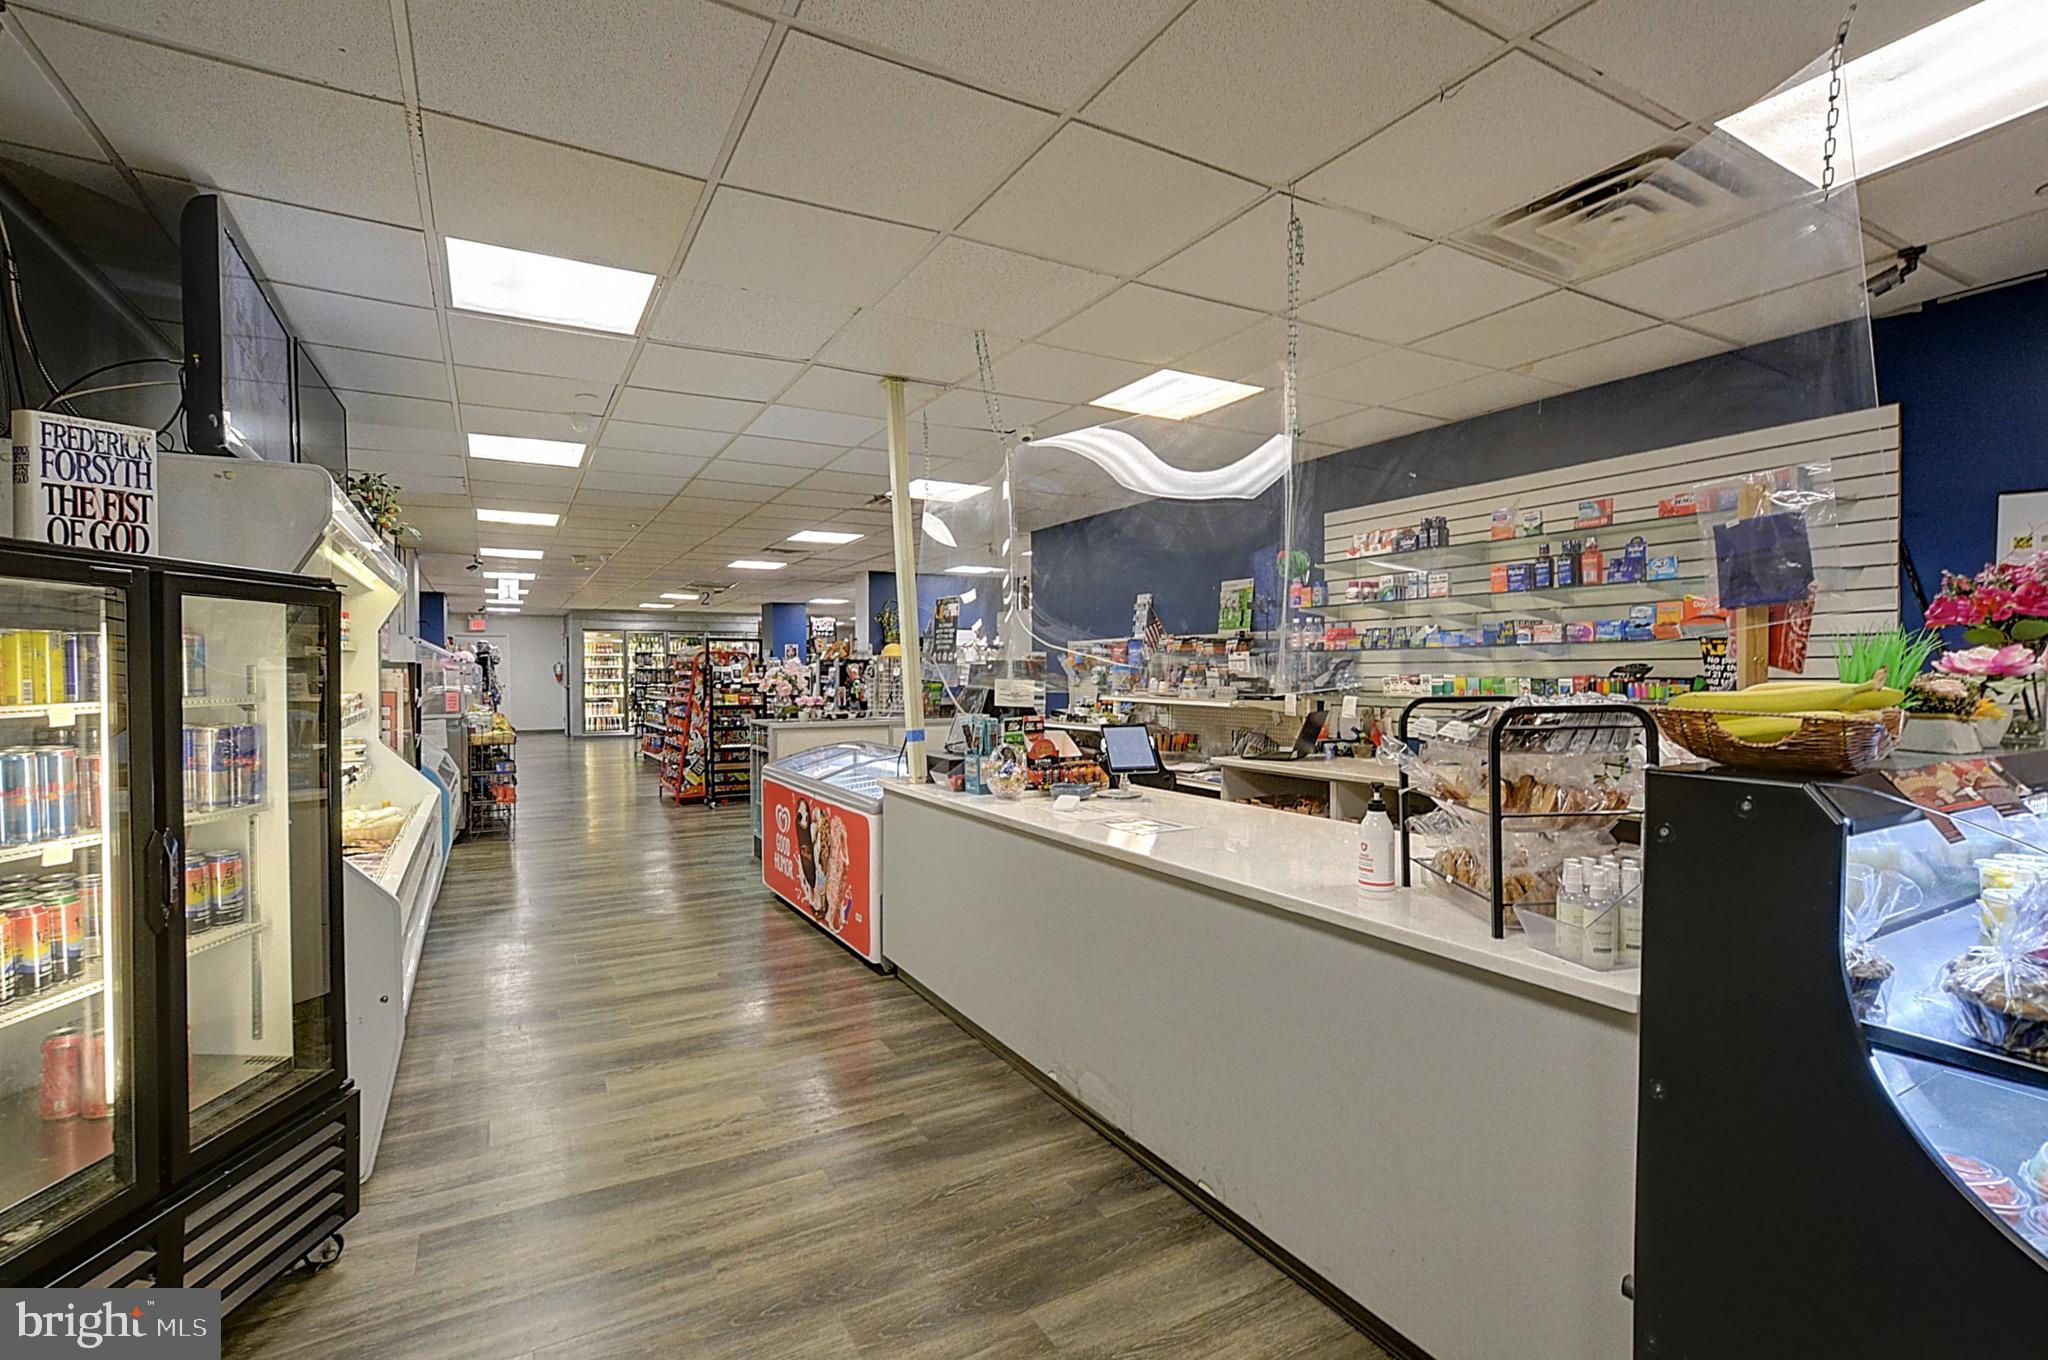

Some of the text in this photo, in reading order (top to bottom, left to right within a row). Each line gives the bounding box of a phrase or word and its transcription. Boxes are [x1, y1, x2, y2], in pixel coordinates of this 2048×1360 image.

[40, 421, 152, 461] FREDERICK
[40, 448, 153, 491] FORSYTH
[41, 482, 154, 524] THE FIST
[47, 517, 150, 555] OF GOD
[504, 584, 514, 599] 1
[701, 591, 710, 605] 2
[1707, 656, 1720, 664] No
[776, 832, 791, 857] GOOD
[774, 850, 794, 880] HUMOR
